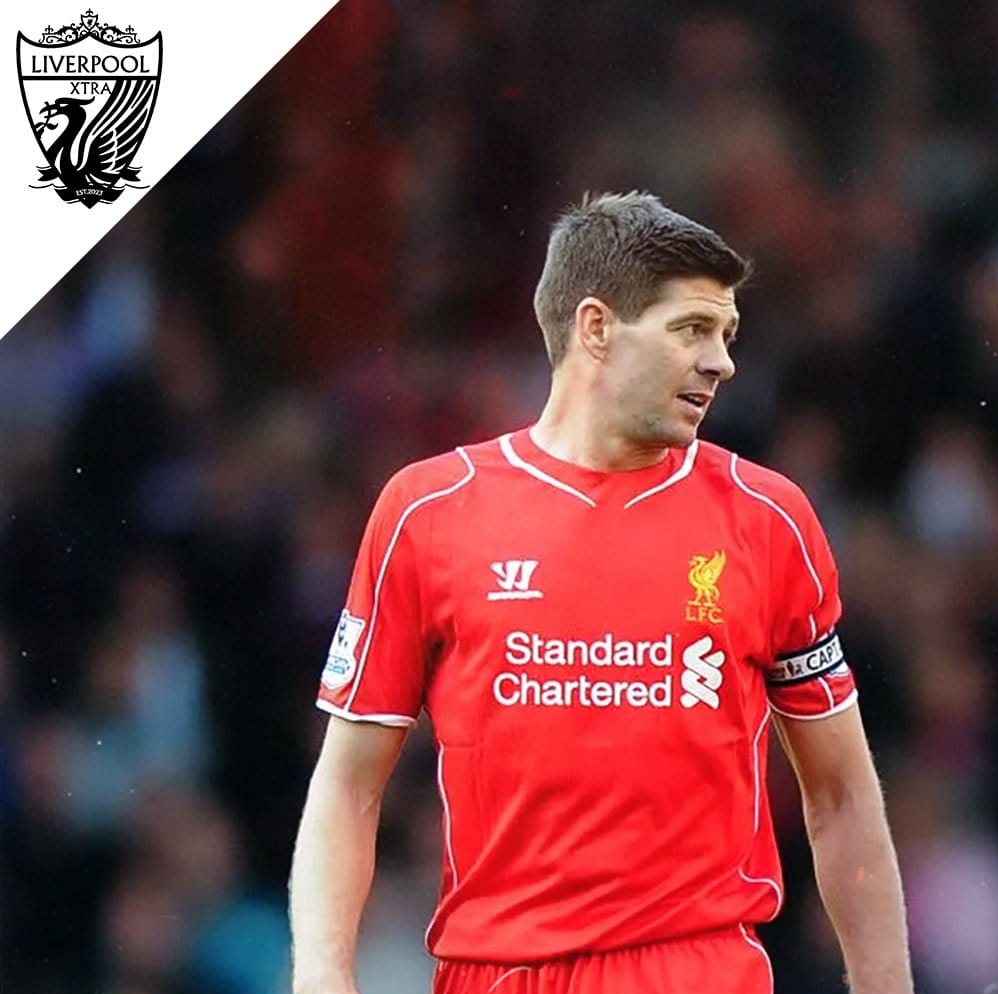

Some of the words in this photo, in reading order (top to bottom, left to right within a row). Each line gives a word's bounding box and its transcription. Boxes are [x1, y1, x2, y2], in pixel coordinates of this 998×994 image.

[686, 606, 723, 623] LFC
[506, 632, 673, 667] Standard
[493, 676, 672, 708] Chartered
